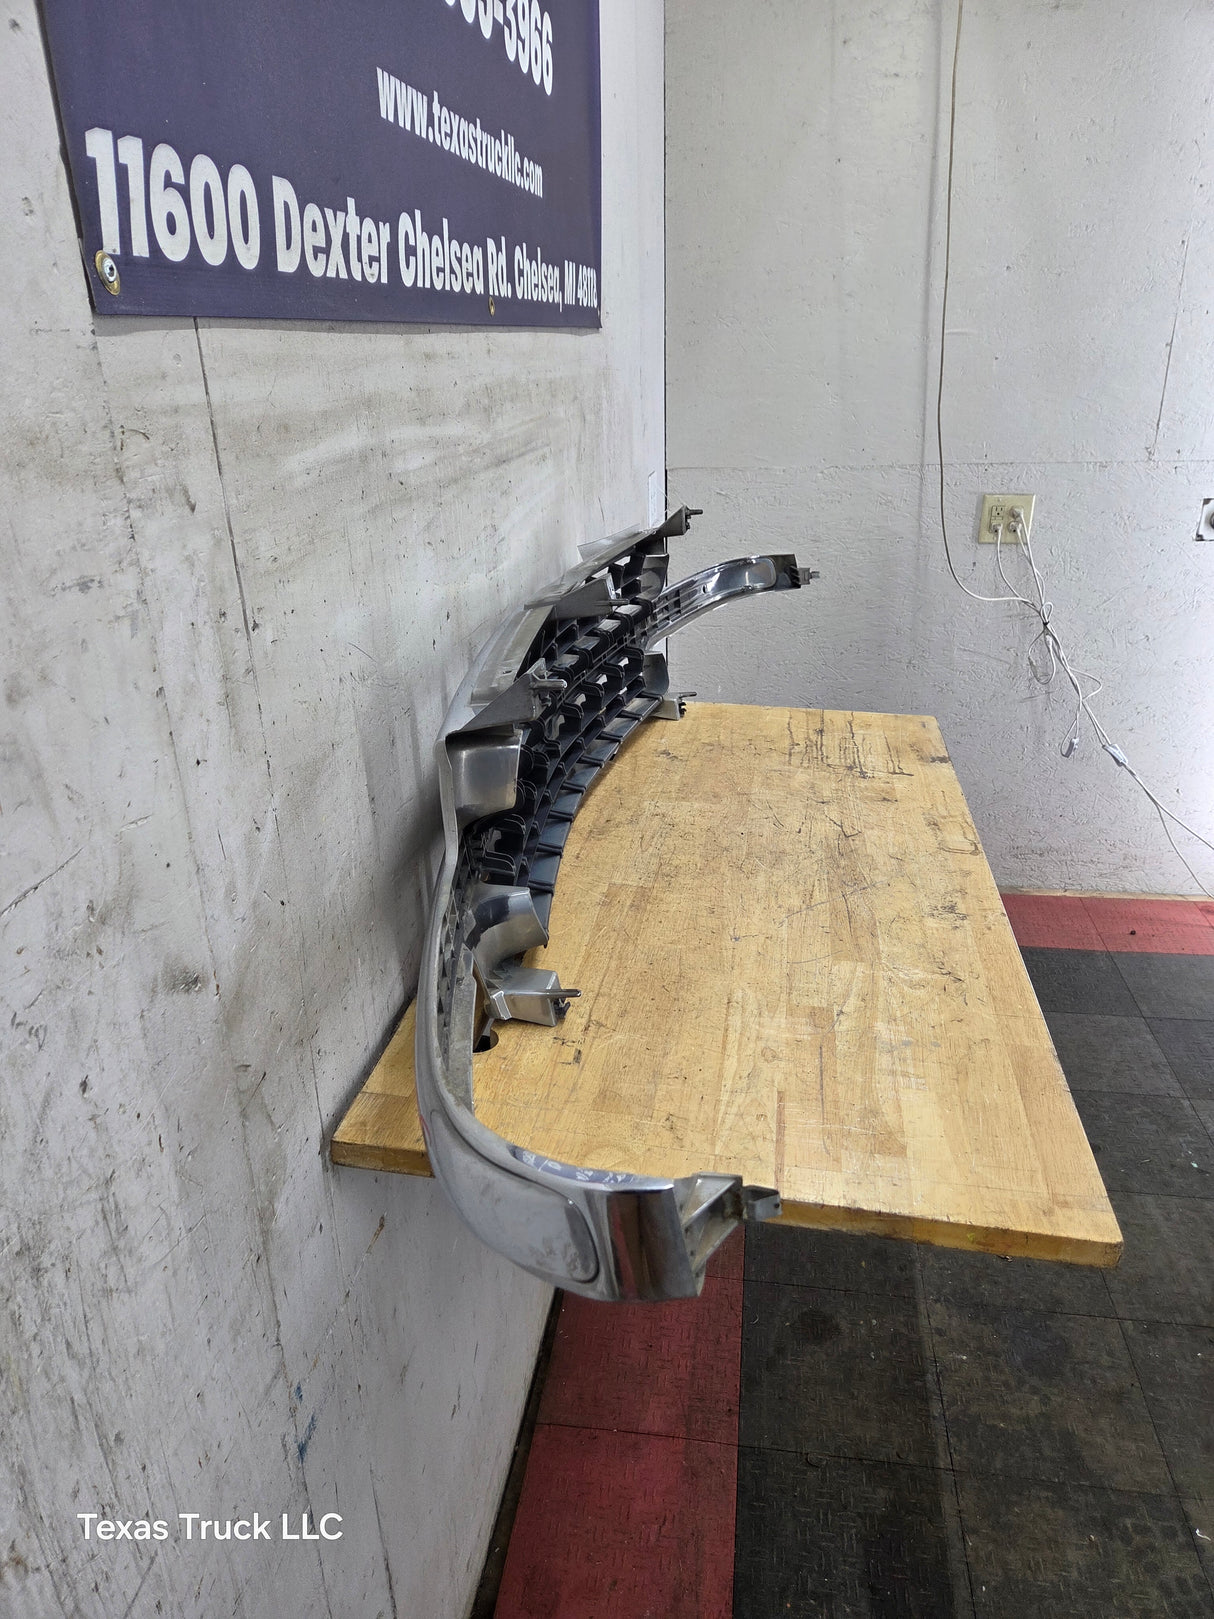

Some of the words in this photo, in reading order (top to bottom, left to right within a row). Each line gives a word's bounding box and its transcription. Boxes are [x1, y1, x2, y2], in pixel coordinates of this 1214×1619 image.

[376, 66, 543, 198] www.texastruckllc.com
[85, 127, 261, 270] 11600
[272, 175, 390, 284] Dexter
[398, 208, 485, 295] Chelsea
[486, 235, 512, 299] Rd.
[514, 242, 562, 313] Chelsea,
[564, 259, 576, 305] MI
